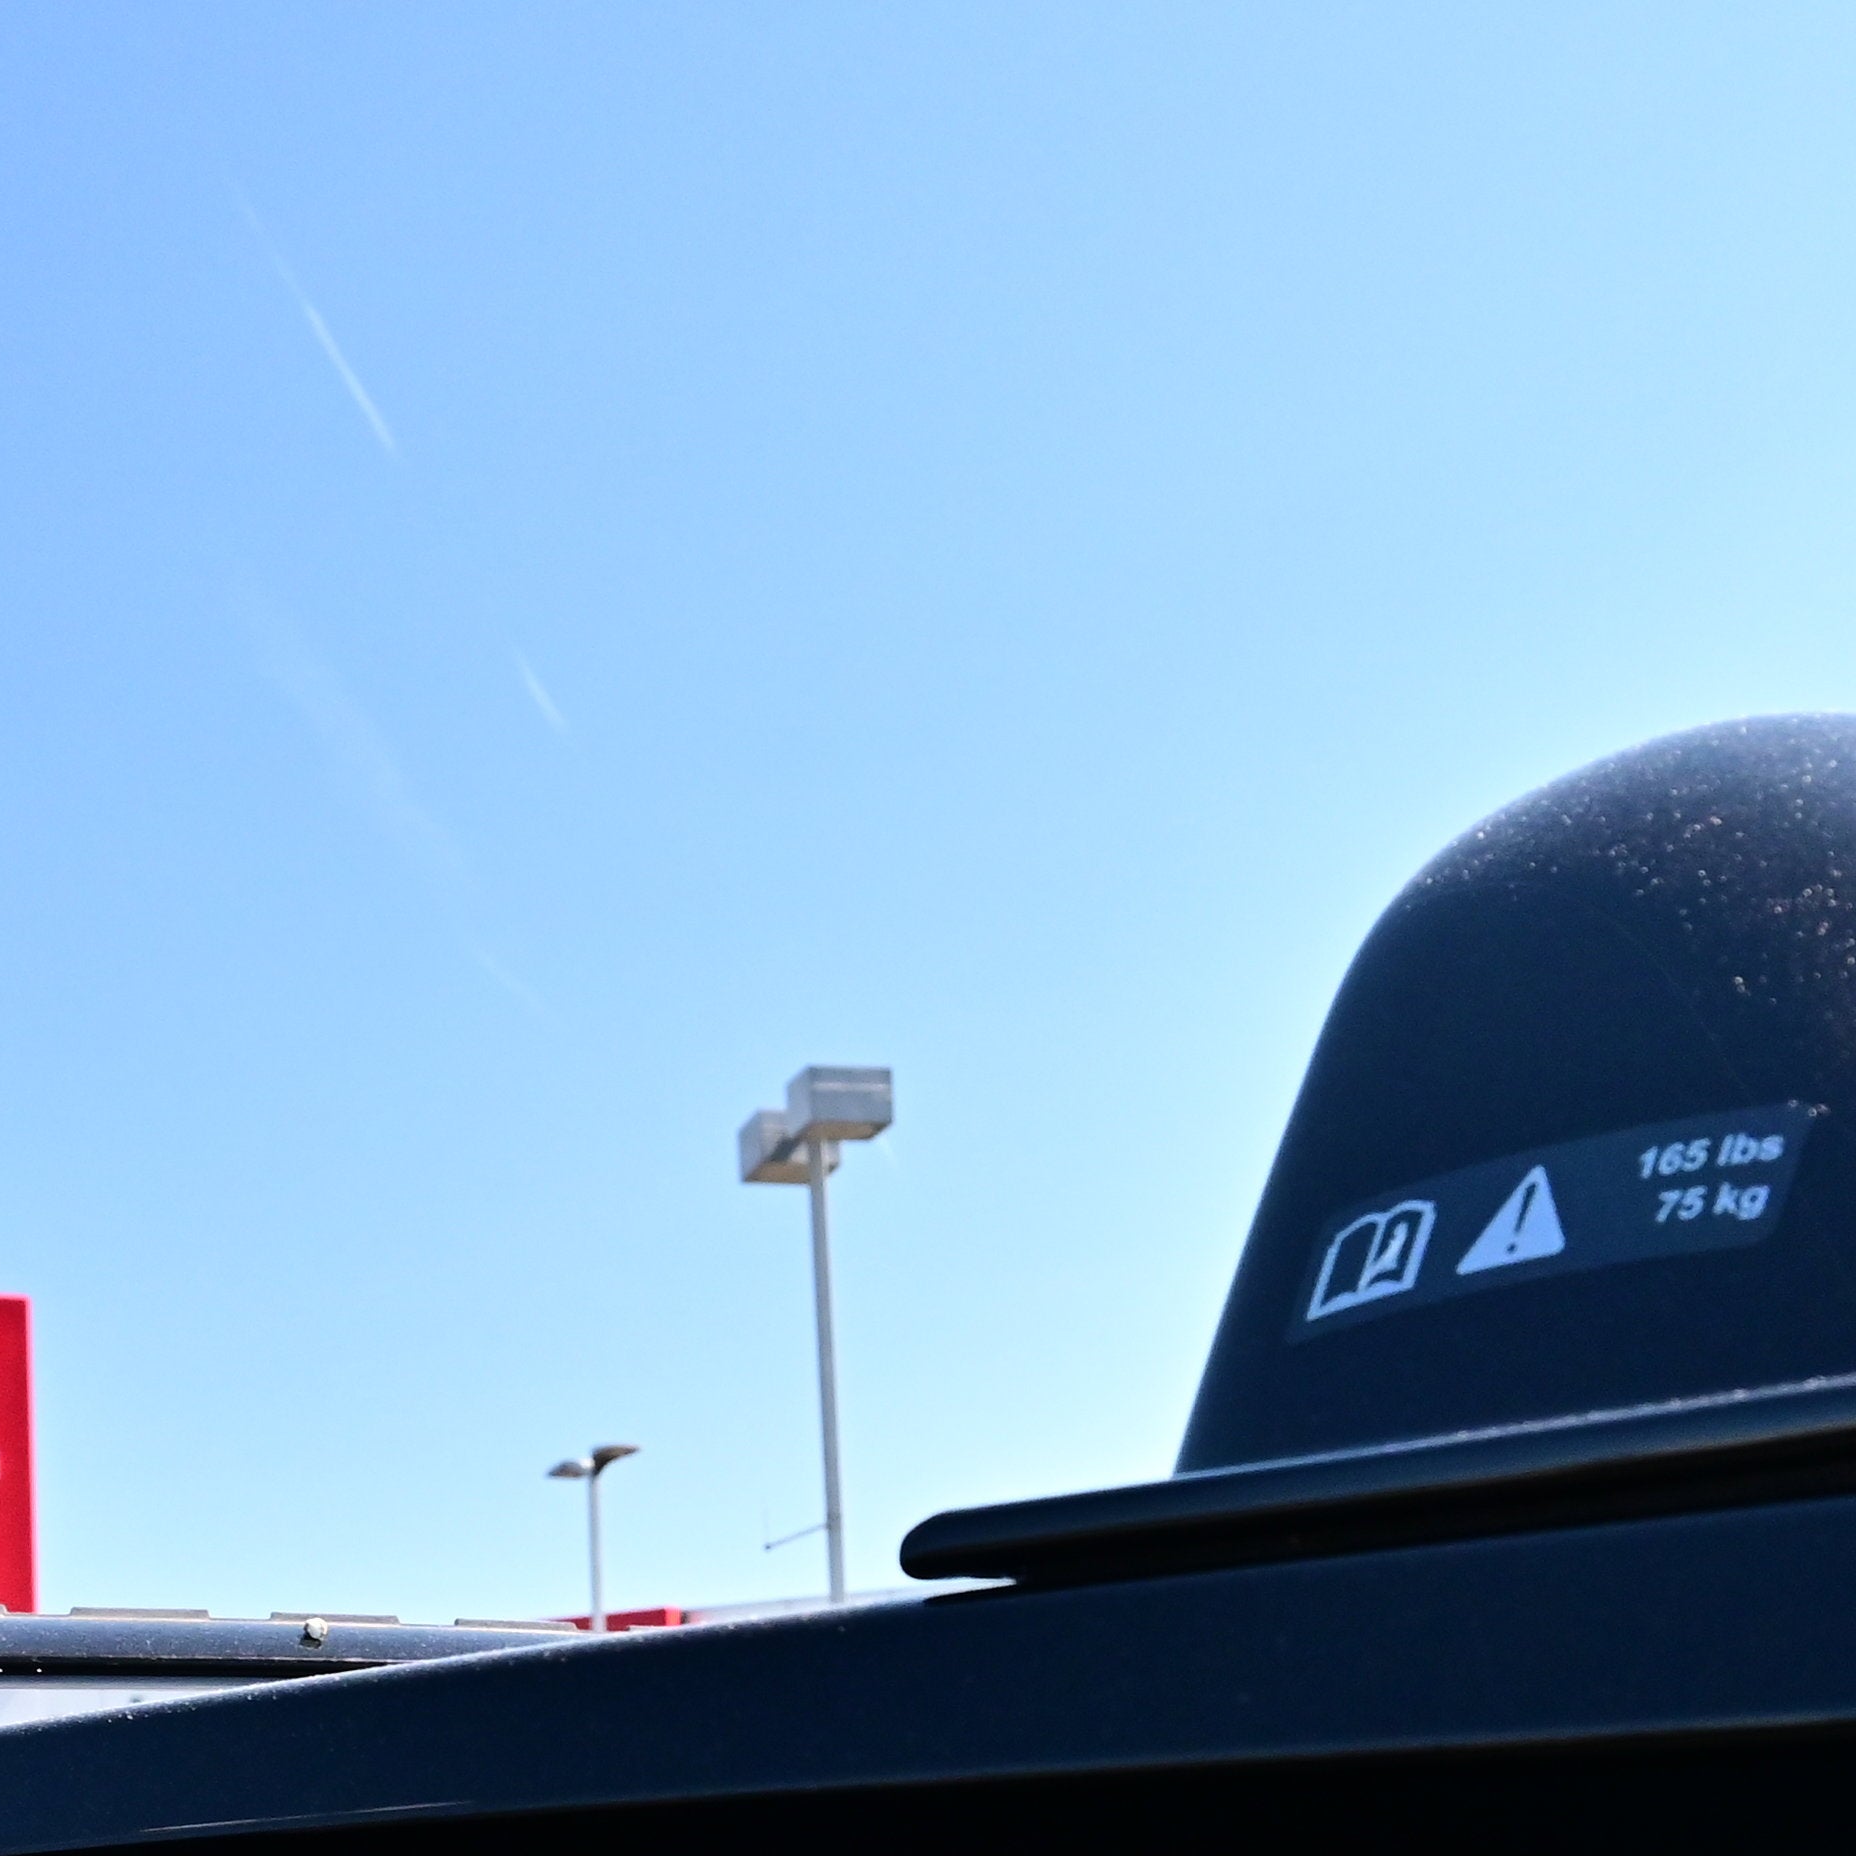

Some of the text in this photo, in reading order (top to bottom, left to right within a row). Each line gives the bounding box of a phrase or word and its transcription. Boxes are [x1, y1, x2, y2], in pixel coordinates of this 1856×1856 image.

[1639, 1132, 1785, 1179] 165 lbs
[1655, 1181, 1771, 1223] 75 kg
